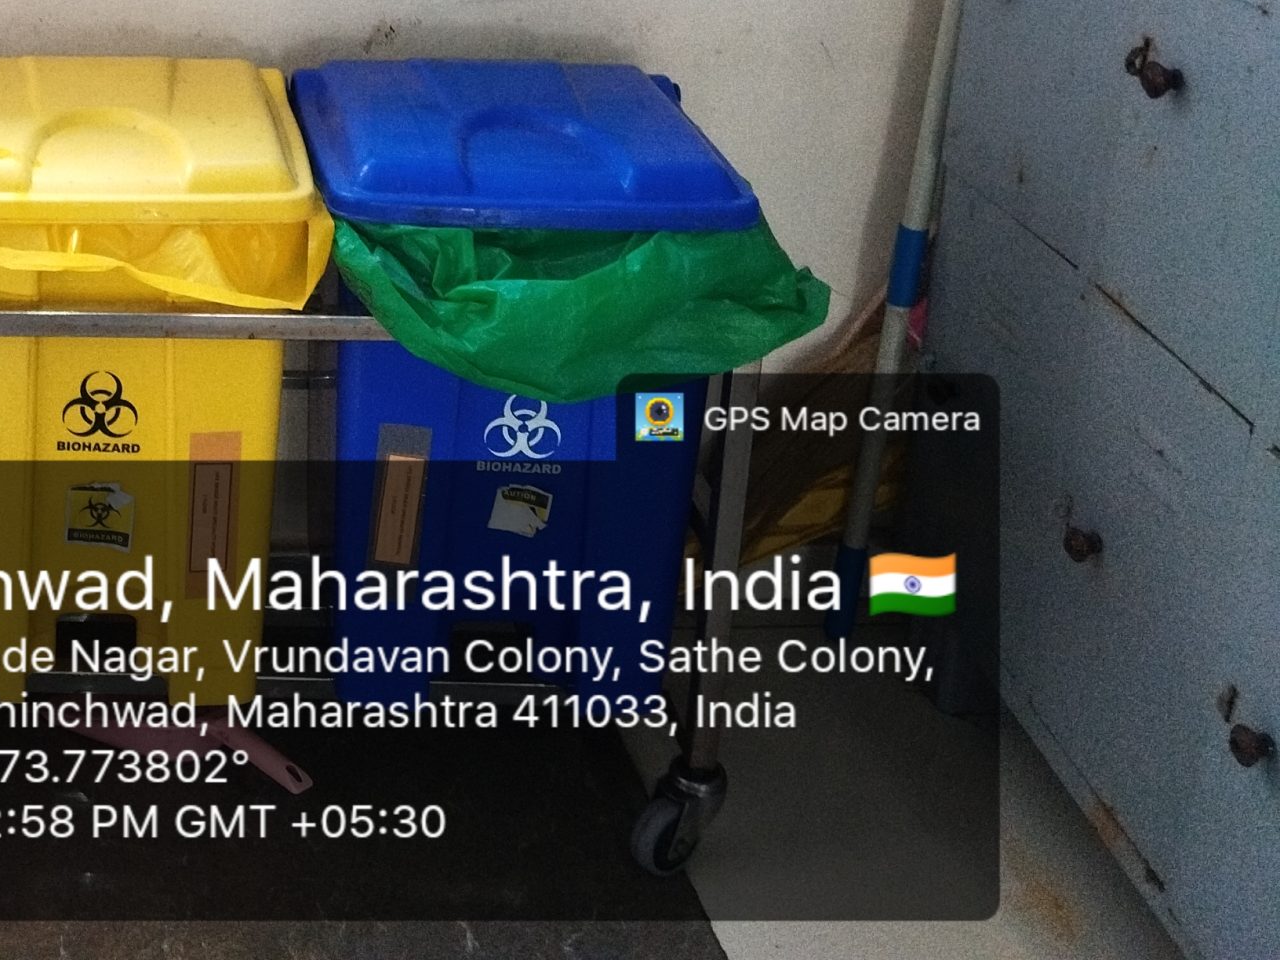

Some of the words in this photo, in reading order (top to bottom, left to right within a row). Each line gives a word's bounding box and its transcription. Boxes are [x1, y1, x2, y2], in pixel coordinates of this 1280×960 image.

[57, 441, 141, 454] BIOHAZARD
[476, 460, 562, 474] BIOHAZARD
[504, 490, 537, 501] AUTION
